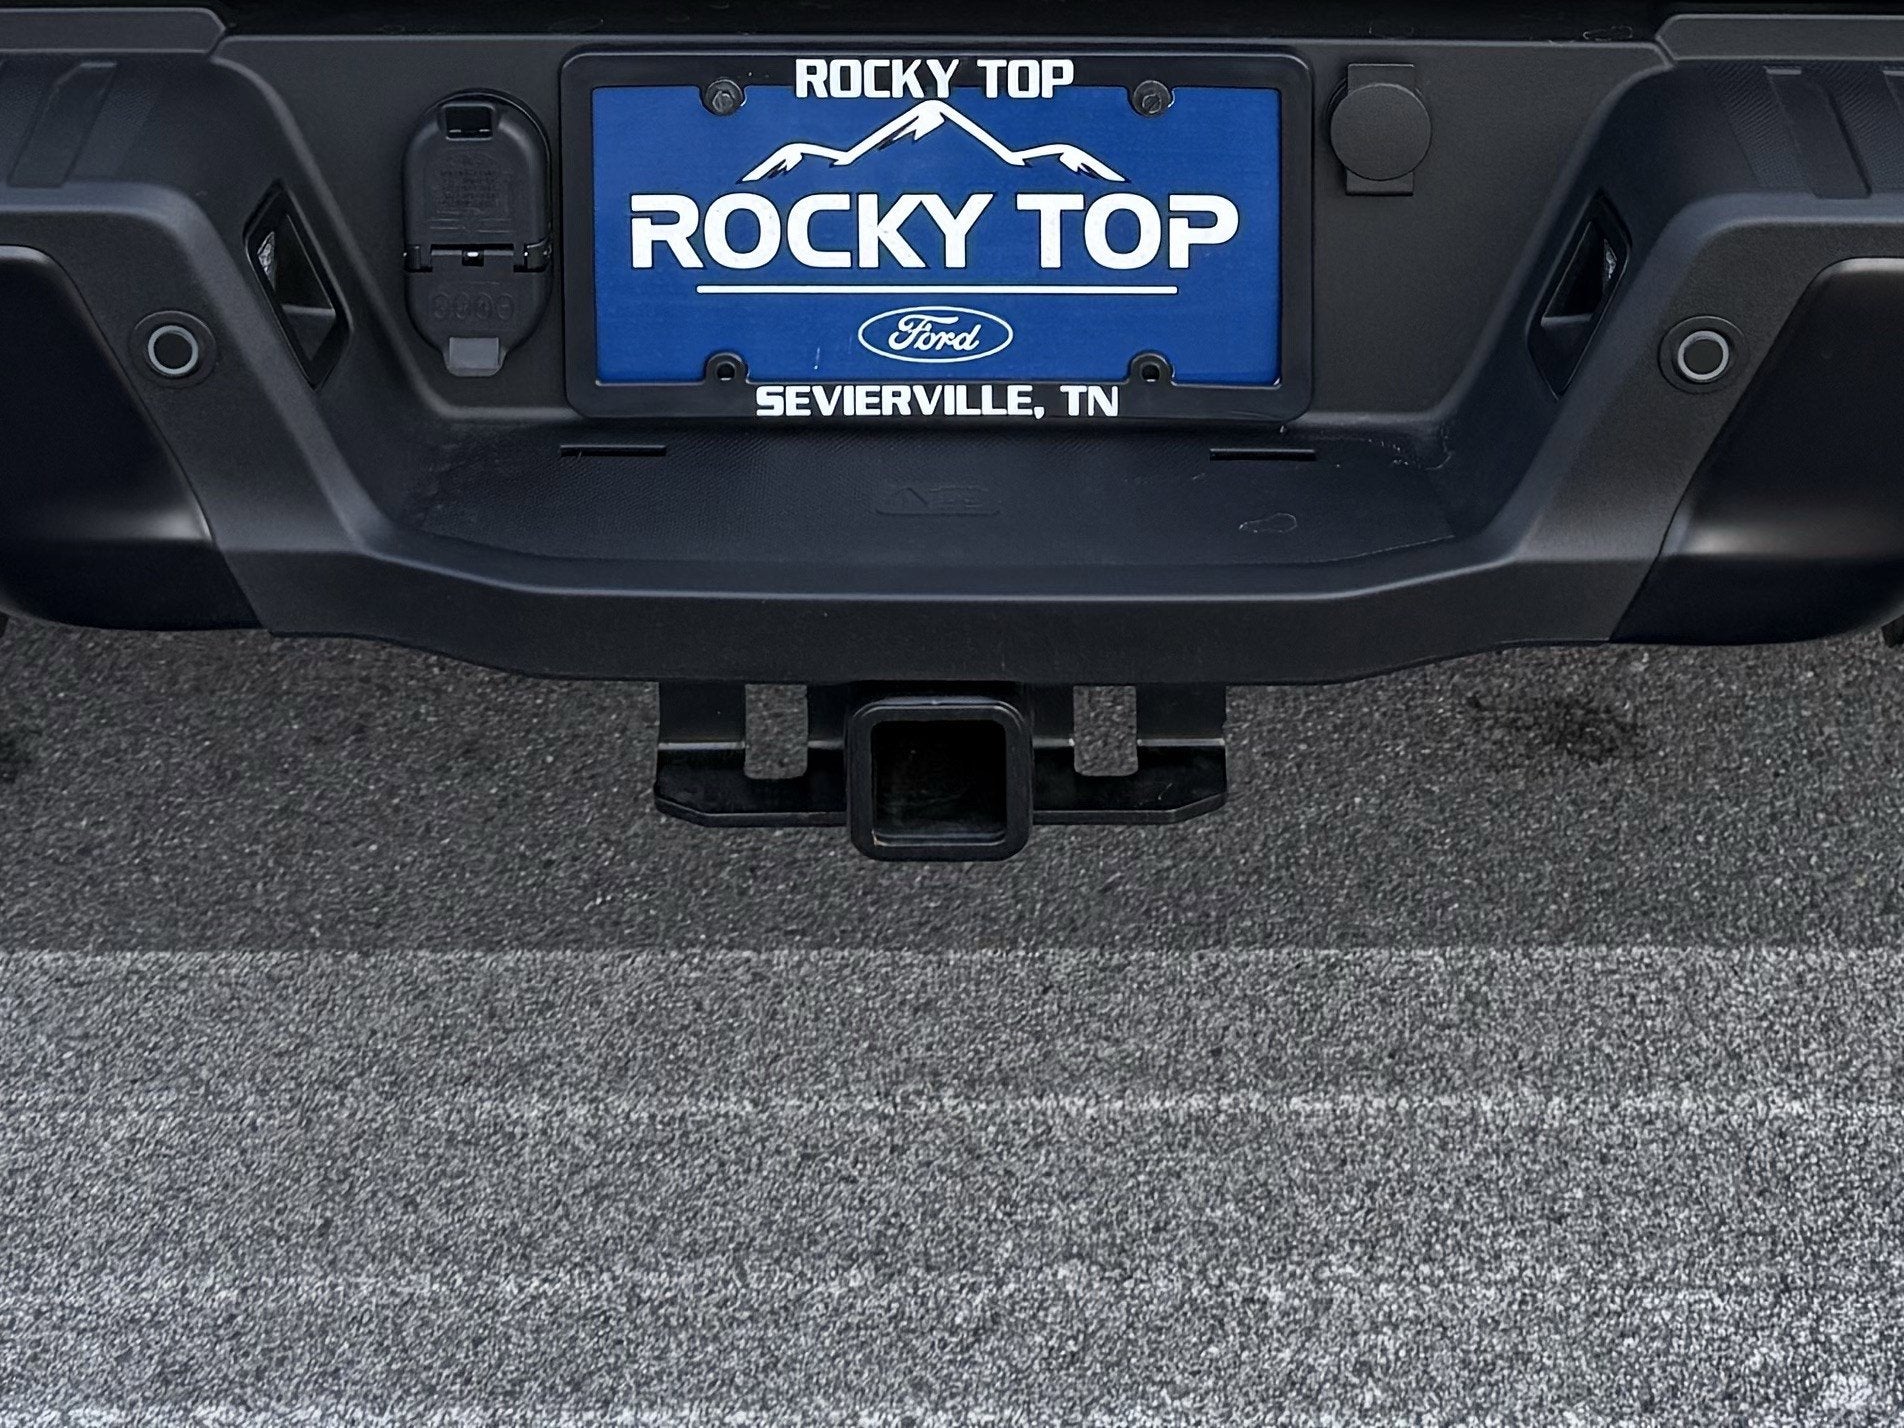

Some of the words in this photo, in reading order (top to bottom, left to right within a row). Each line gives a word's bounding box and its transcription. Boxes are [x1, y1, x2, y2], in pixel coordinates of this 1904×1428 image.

[795, 58, 960, 99] ROCKY
[977, 58, 1075, 98] TOP
[630, 192, 995, 270] ROCKY
[1016, 192, 1240, 270] TOP
[887, 312, 981, 353] Ford
[756, 384, 1045, 420] SEVIERVILLE,
[1060, 384, 1120, 416] TN
